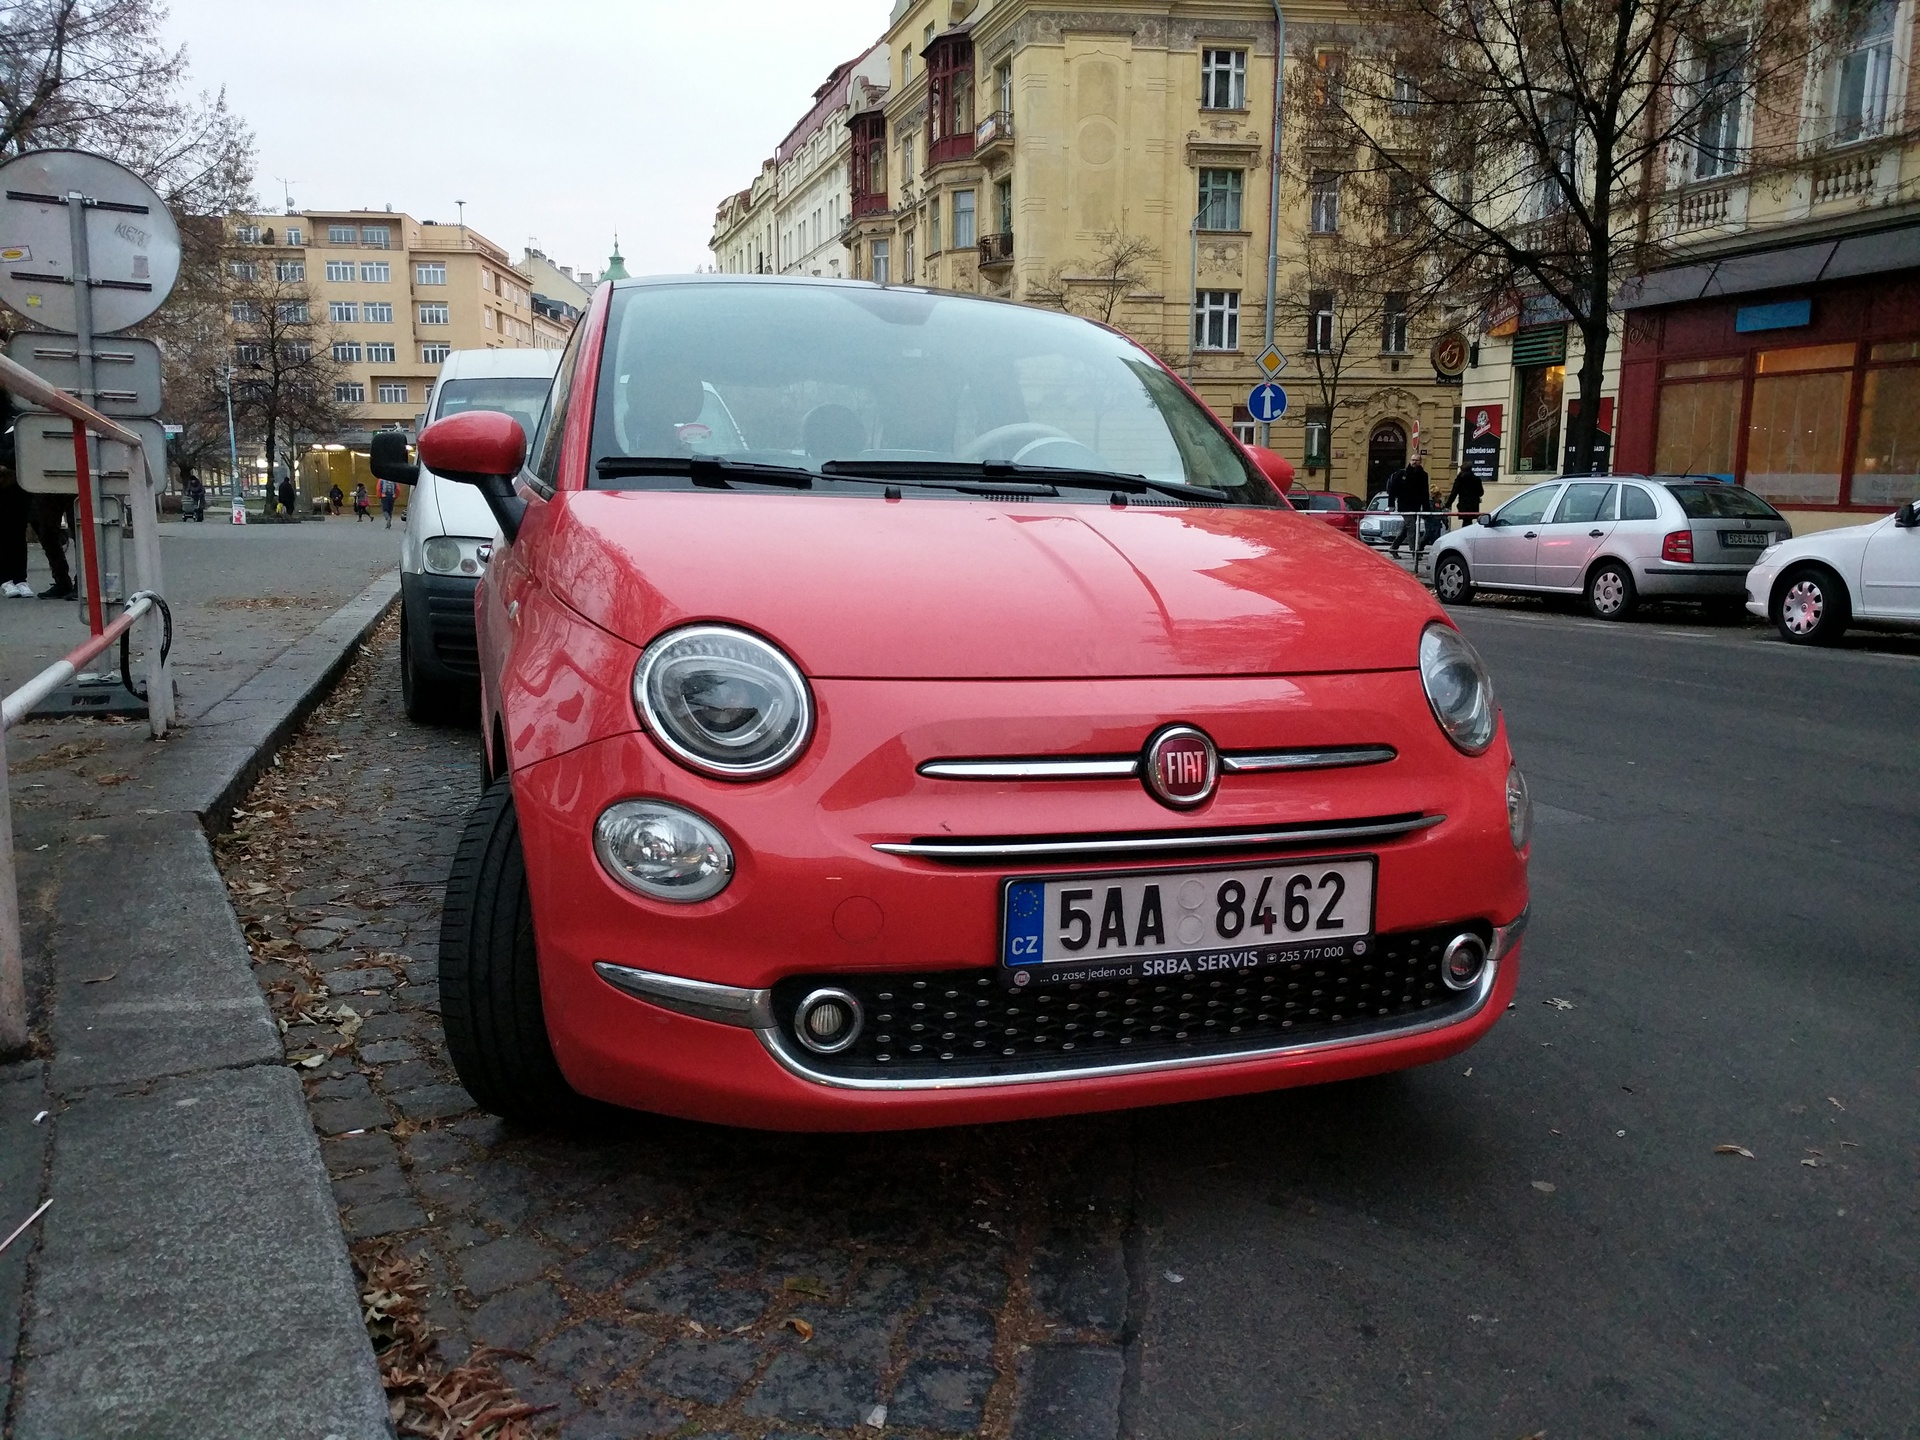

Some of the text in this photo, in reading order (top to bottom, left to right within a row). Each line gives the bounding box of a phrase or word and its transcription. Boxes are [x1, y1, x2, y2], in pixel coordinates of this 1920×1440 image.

[1166, 751, 1204, 784] FIAT
[1060, 869, 1346, 951] 5AA 8462
[1011, 935, 1038, 955] CZ
[1051, 972, 1060, 981] a
[1062, 970, 1086, 981] zase
[1087, 966, 1116, 981] jeden
[1118, 965, 1133, 976] od
[1142, 957, 1193, 976] SRBA
[1197, 951, 1258, 971] SERVIS
[1279, 951, 1300, 963] 255
[1303, 948, 1321, 960] 717
[1323, 946, 1344, 958] 000
